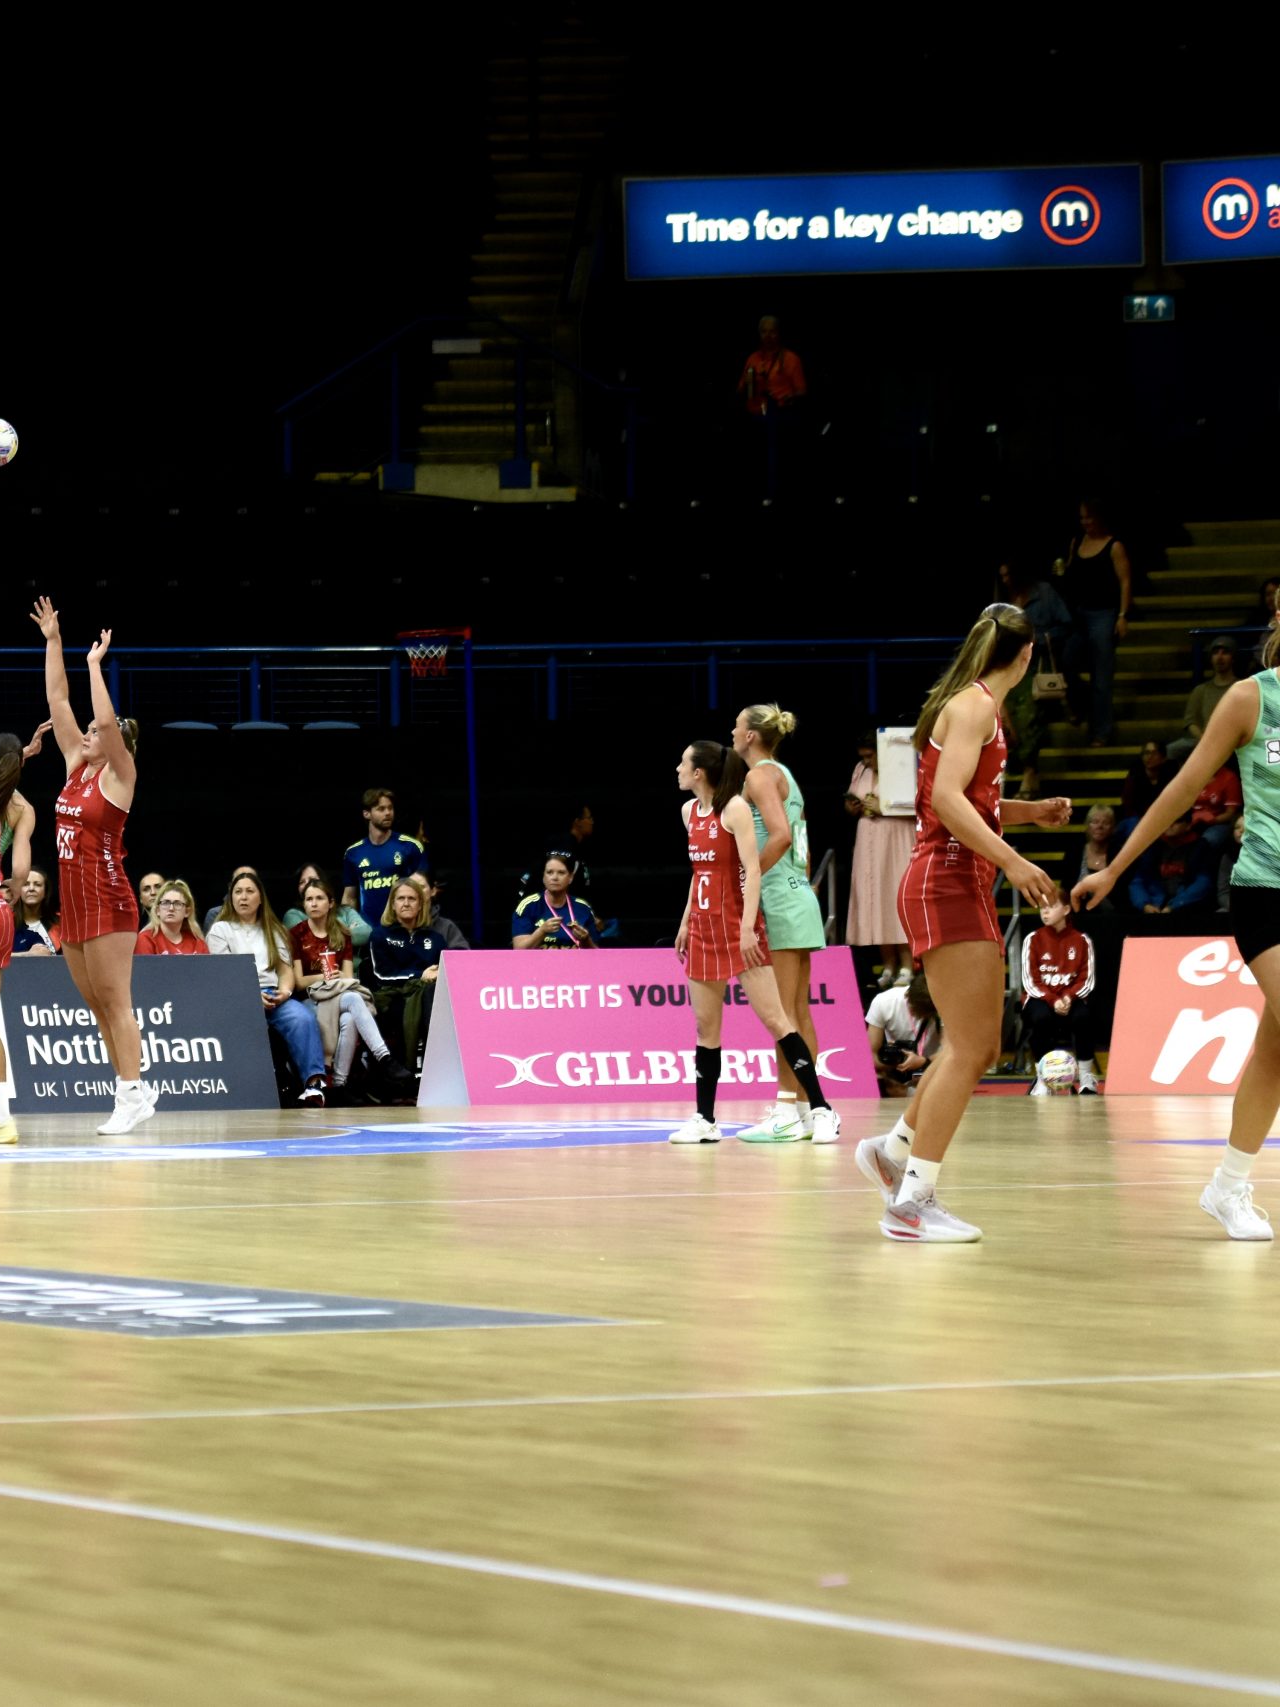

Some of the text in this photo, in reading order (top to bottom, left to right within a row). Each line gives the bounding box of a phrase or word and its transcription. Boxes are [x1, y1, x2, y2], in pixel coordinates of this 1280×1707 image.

[665, 204, 1023, 243] Time for a key change
[55, 803, 82, 817] next
[364, 874, 399, 890] next
[697, 876, 709, 909] C
[479, 985, 591, 1011] GILBERT
[599, 984, 623, 1008] IS
[628, 984, 691, 1007] YOU
[21, 1002, 173, 1031] Univey of
[26, 1031, 224, 1072] Nottigham
[34, 1082, 58, 1098] UK
[147, 1079, 228, 1095] MALAYSIA
